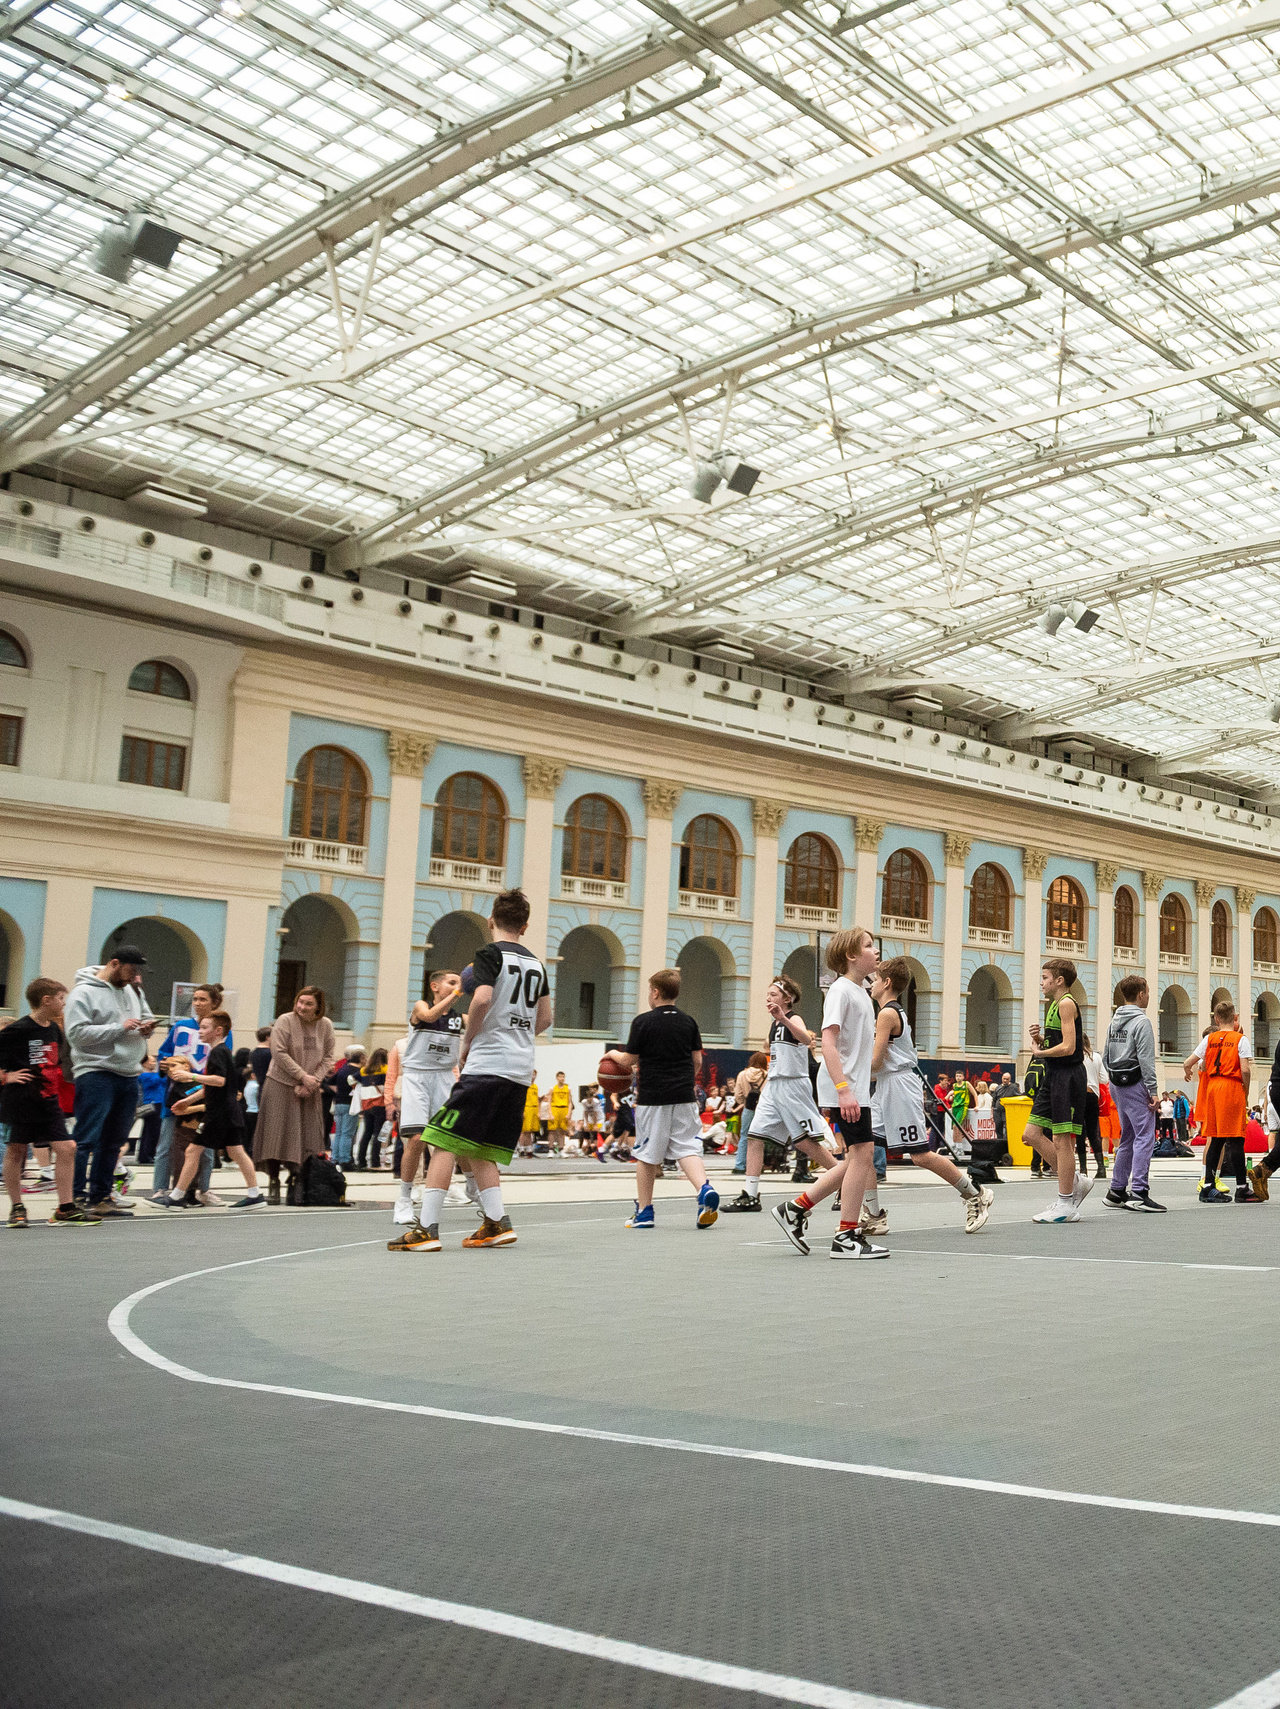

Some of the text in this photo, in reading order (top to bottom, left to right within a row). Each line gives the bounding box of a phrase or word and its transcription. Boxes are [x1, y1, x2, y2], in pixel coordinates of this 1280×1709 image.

[508, 964, 542, 1008] 70
[774, 1026, 785, 1041] 21
[799, 1117, 814, 1133] 21
[898, 1124, 919, 1143] 28
